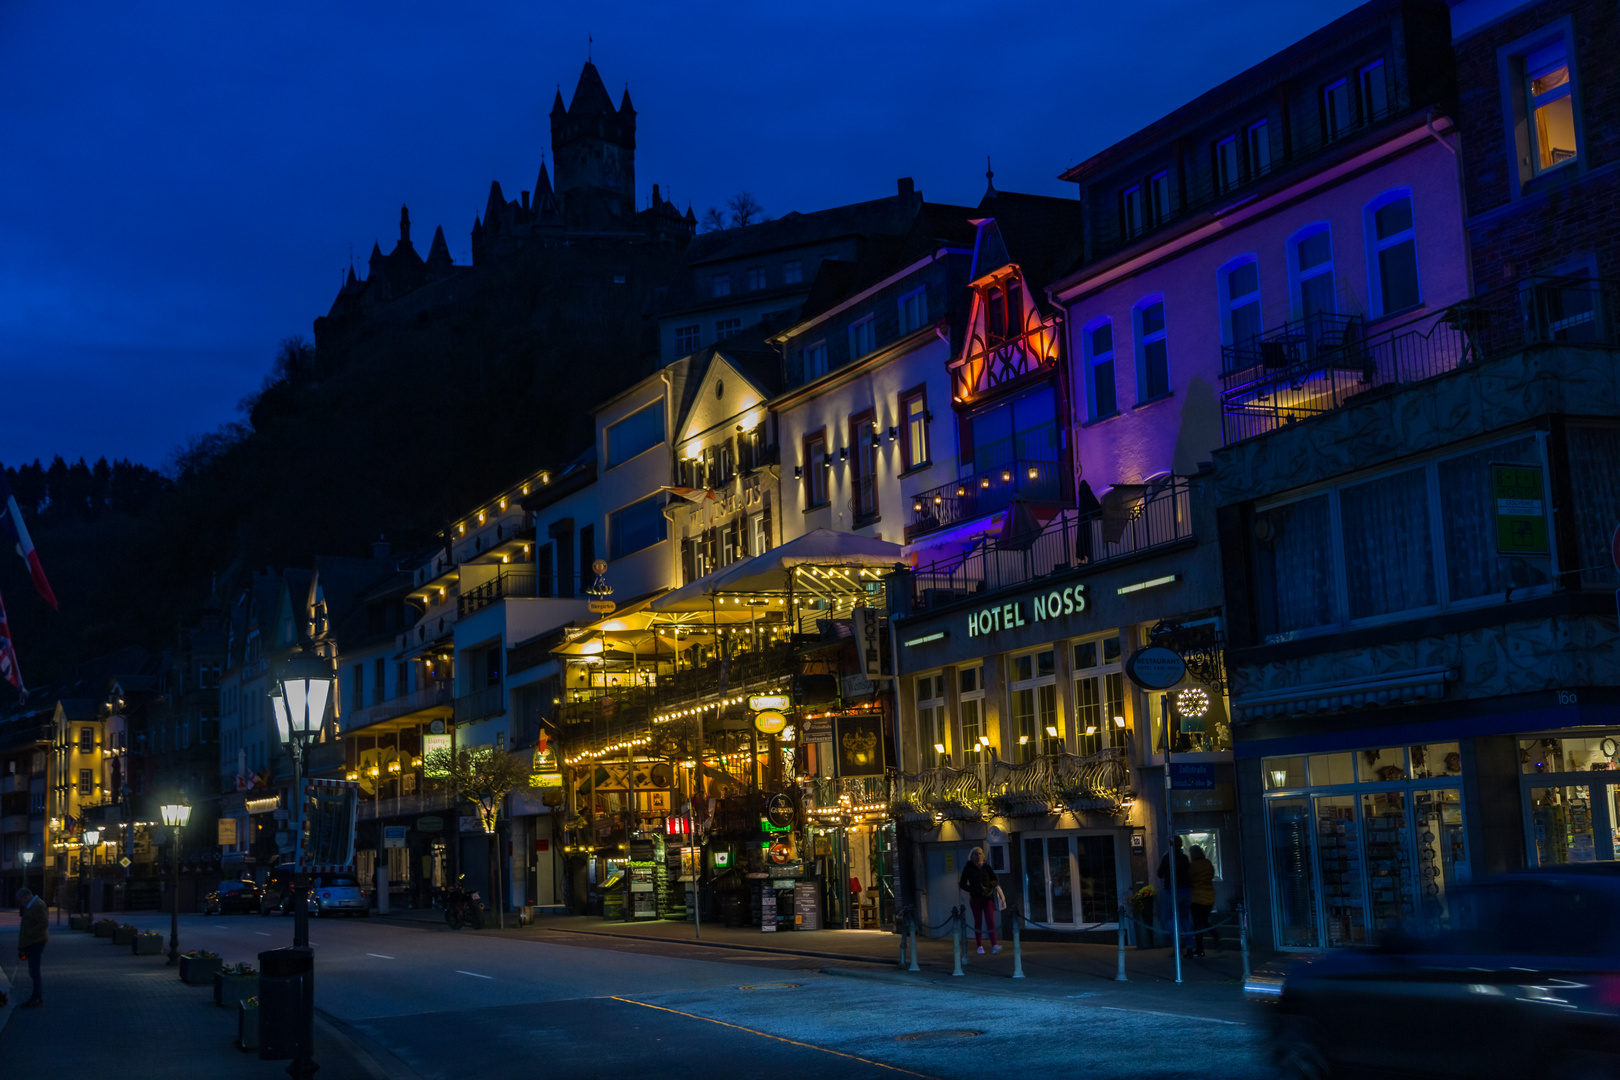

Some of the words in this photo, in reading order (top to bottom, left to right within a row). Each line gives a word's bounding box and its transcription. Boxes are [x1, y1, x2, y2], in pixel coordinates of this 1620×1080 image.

[968, 601, 1025, 638] HOTEL
[1033, 584, 1085, 622] NOSS
[863, 610, 879, 674] HOTEL
[1136, 657, 1180, 665] RESTAURANT
